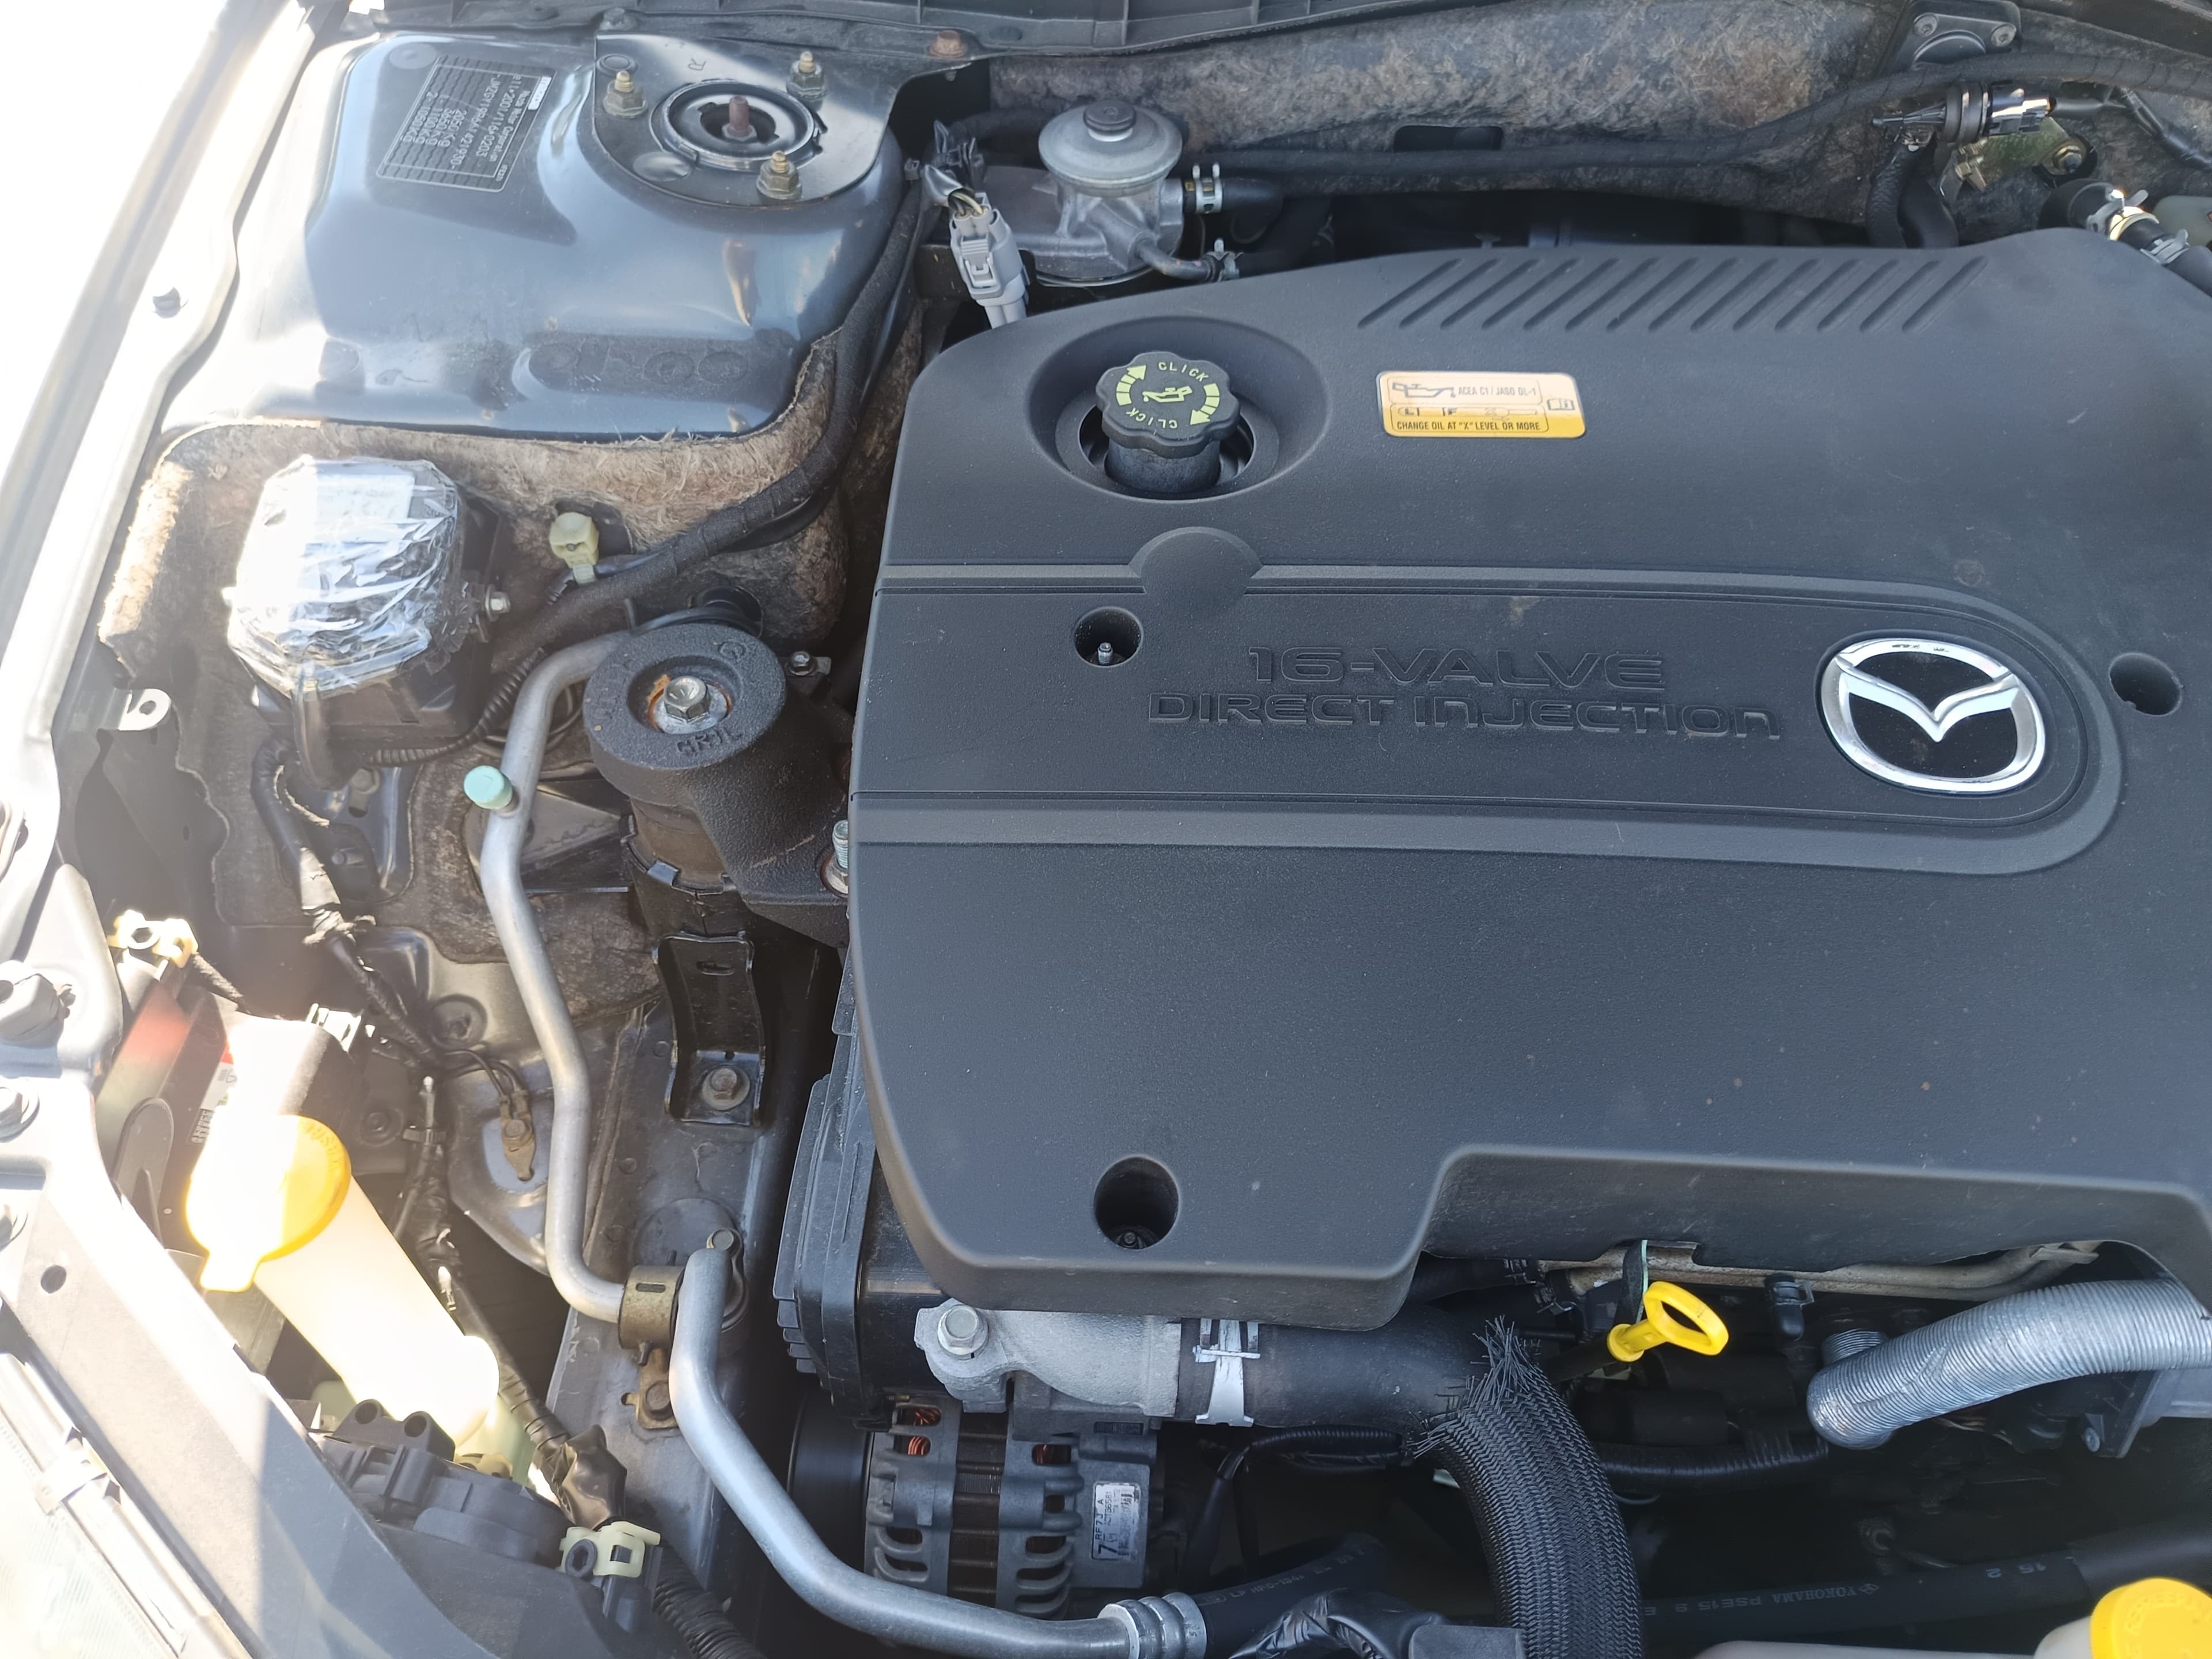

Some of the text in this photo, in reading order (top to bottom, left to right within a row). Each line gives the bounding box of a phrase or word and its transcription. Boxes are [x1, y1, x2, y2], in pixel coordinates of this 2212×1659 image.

[1158, 362, 1209, 382] CLICK
[1459, 387, 1475, 396] ACEA
[1496, 387, 1515, 396] JASO
[1126, 407, 1177, 429] CLICK
[1397, 421, 1430, 430] CHANGE
[1431, 421, 1445, 430] OIL
[1448, 421, 1457, 430] AT
[1475, 421, 1499, 431] LEVEL
[1502, 421, 1514, 431] OR
[1516, 421, 1540, 431] MORE
[1248, 646, 1665, 691] 16-VALVE
[1149, 692, 1395, 725] DIRECT
[1771, 1586, 1858, 1604] YOKOHAMA
